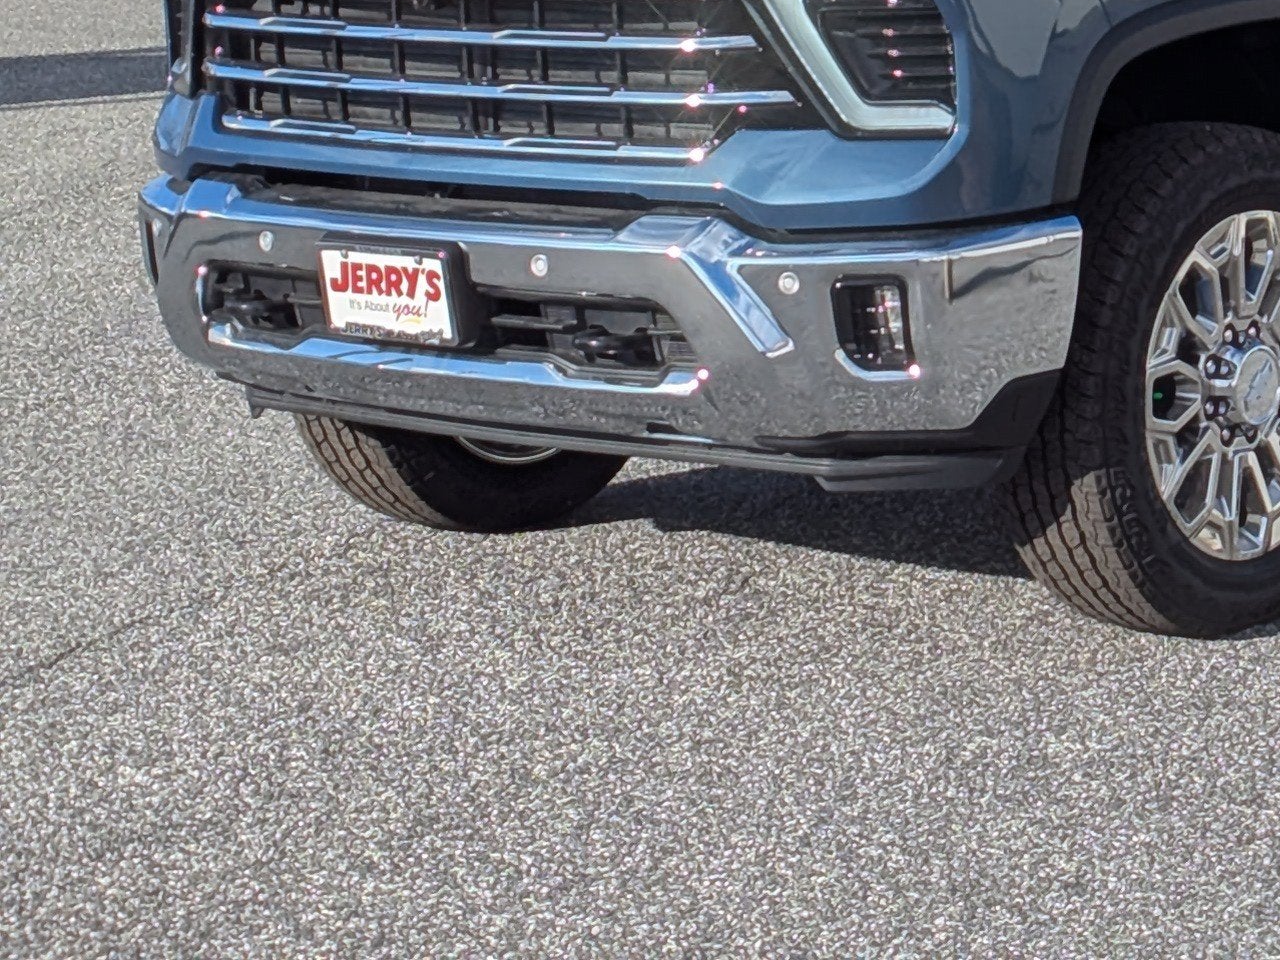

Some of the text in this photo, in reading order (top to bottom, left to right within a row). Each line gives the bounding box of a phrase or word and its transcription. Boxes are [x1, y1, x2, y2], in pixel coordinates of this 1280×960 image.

[329, 260, 442, 302] JERRY'S
[349, 298, 429, 322] It's About you!
